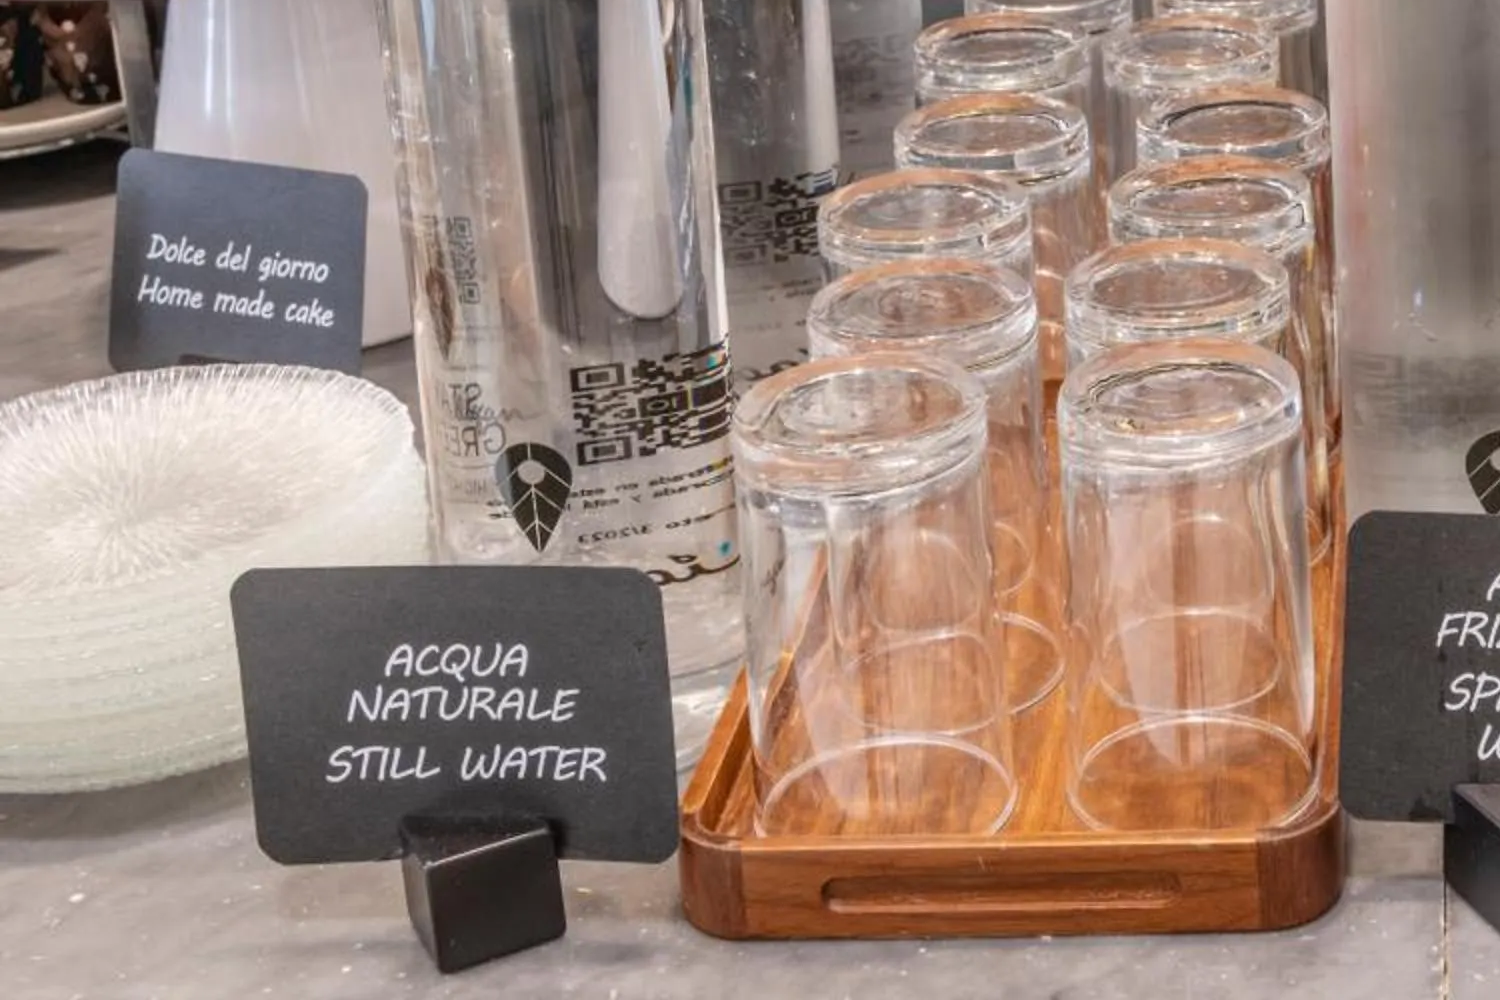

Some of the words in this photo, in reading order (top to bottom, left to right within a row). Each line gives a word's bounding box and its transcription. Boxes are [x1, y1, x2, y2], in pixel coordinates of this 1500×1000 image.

[146, 233, 207, 267] Dolce
[215, 240, 252, 273] del
[257, 250, 330, 284] giorno
[137, 274, 204, 310] Home
[212, 288, 275, 320] made
[283, 297, 335, 328] cake
[384, 642, 529, 683] ACQUA
[346, 684, 580, 723] NATURALE
[325, 745, 441, 783] STILL
[460, 743, 607, 782] WATER
